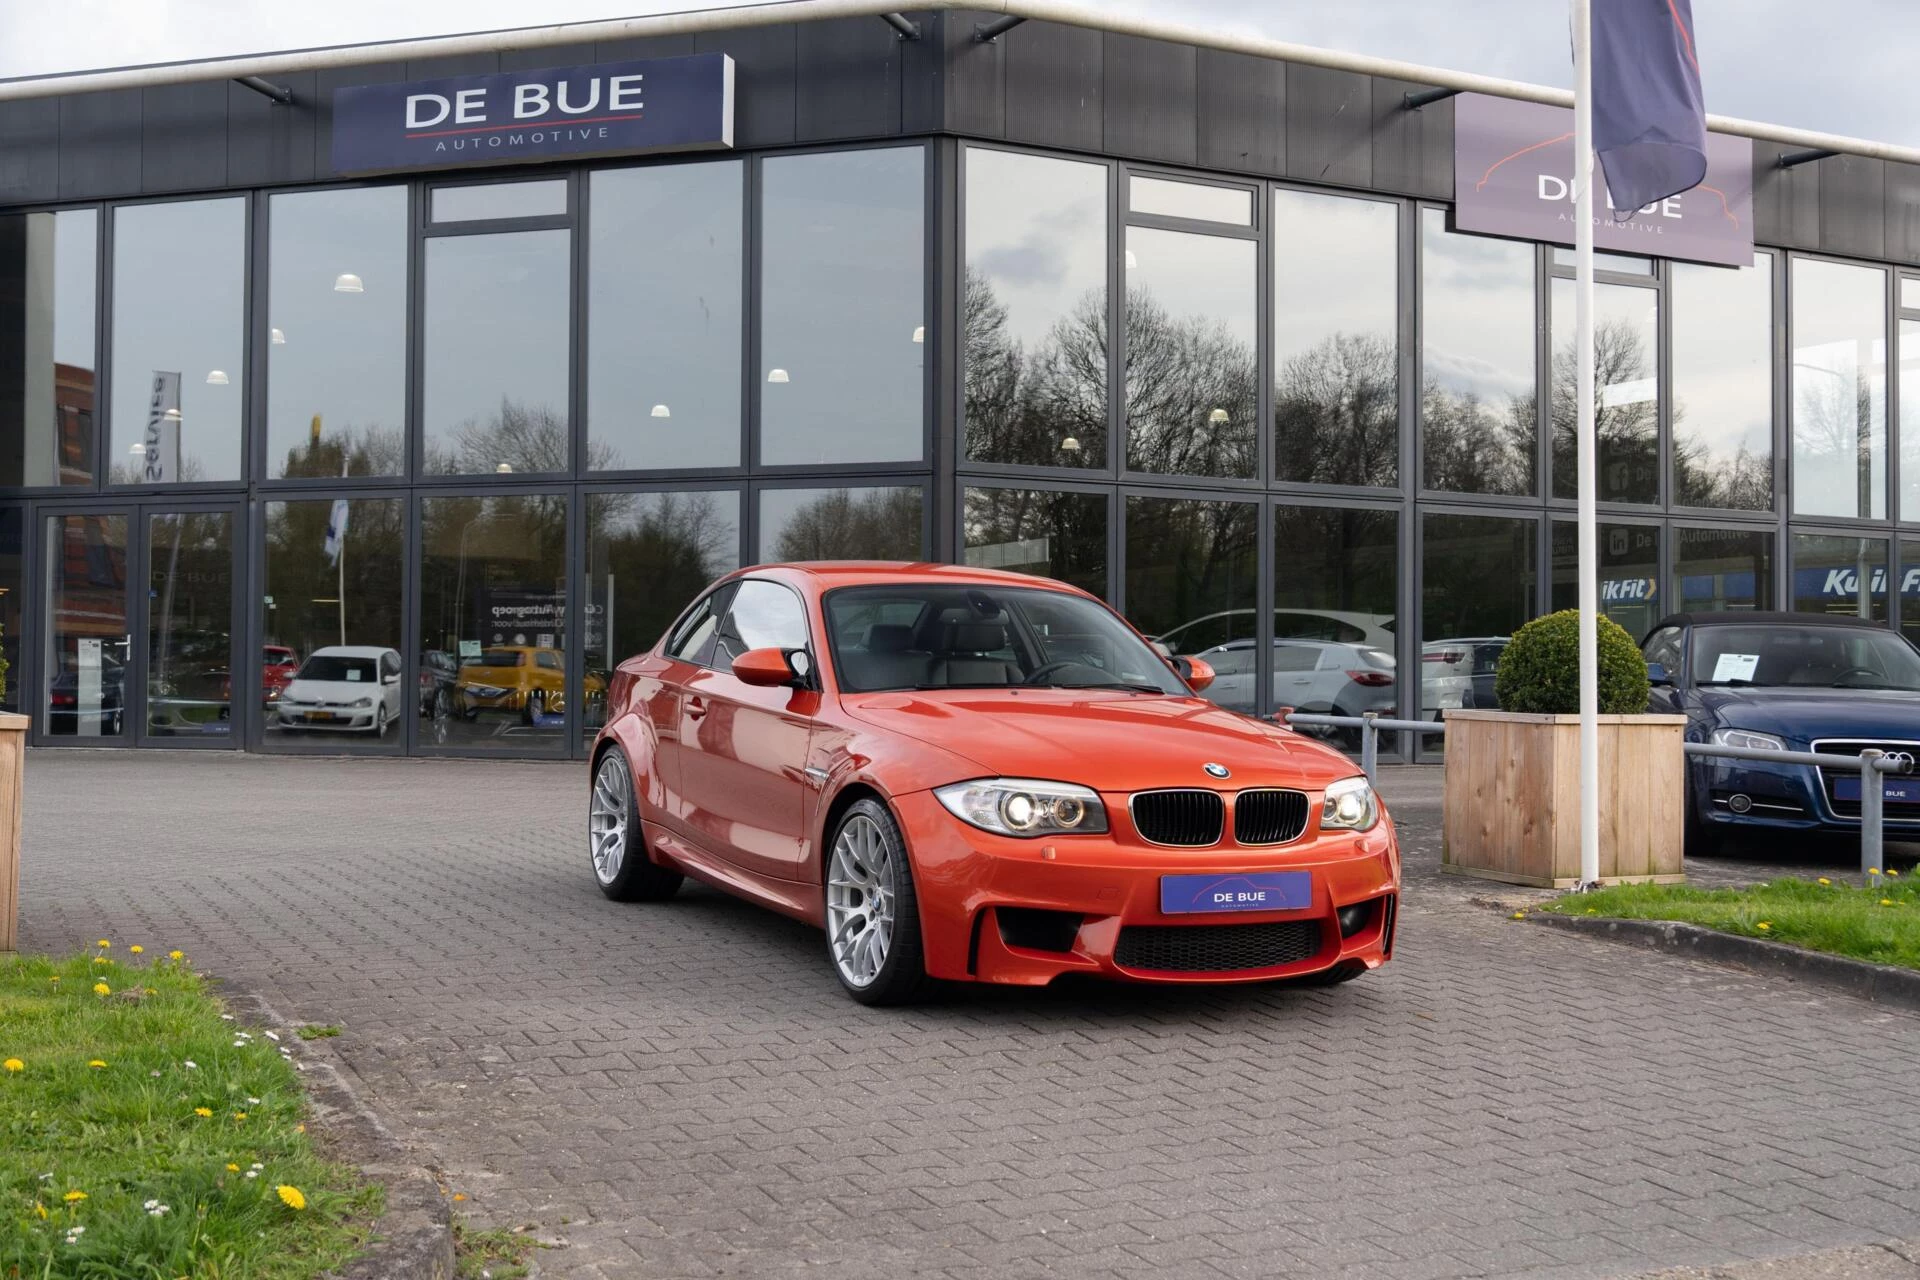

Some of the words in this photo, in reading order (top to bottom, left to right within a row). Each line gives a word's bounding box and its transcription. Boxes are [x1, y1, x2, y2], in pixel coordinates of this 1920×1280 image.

[406, 88, 487, 129] DE
[513, 74, 644, 119] BUE
[435, 127, 608, 152] AUTOMOTIVE
[1558, 212, 1664, 234] AUOMOTIVE
[1885, 790, 1906, 798] BUE
[1213, 893, 1233, 903] DE
[1238, 891, 1266, 902] BUE
